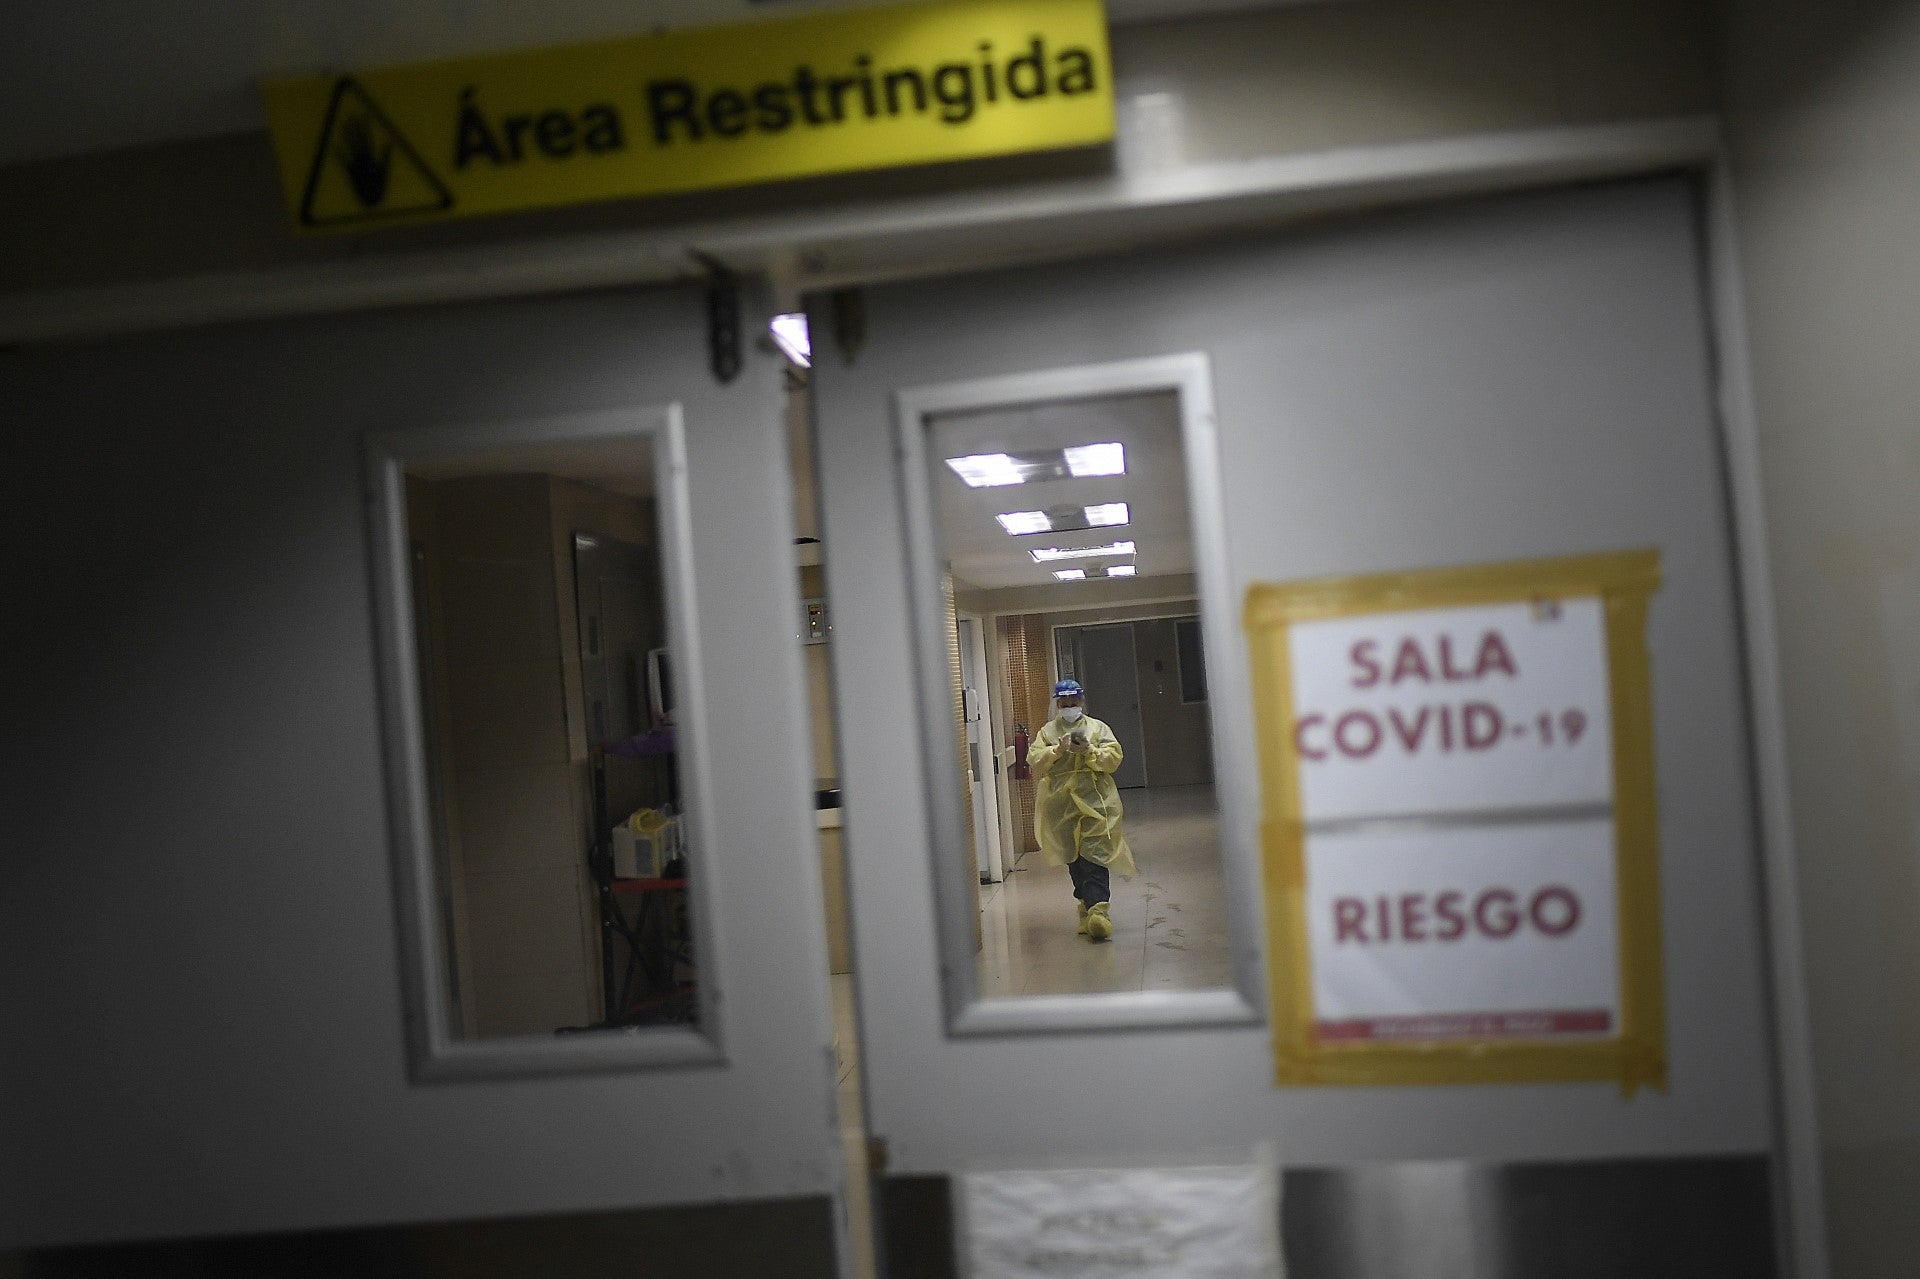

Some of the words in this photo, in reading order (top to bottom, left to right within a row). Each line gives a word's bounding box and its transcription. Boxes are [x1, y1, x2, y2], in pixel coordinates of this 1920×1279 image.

[454, 89, 625, 170] Área
[649, 36, 1094, 147] Restringida
[1349, 630, 1517, 688] SALA
[1294, 702, 1588, 760] COVID-19
[1332, 886, 1580, 945] RIESGO
